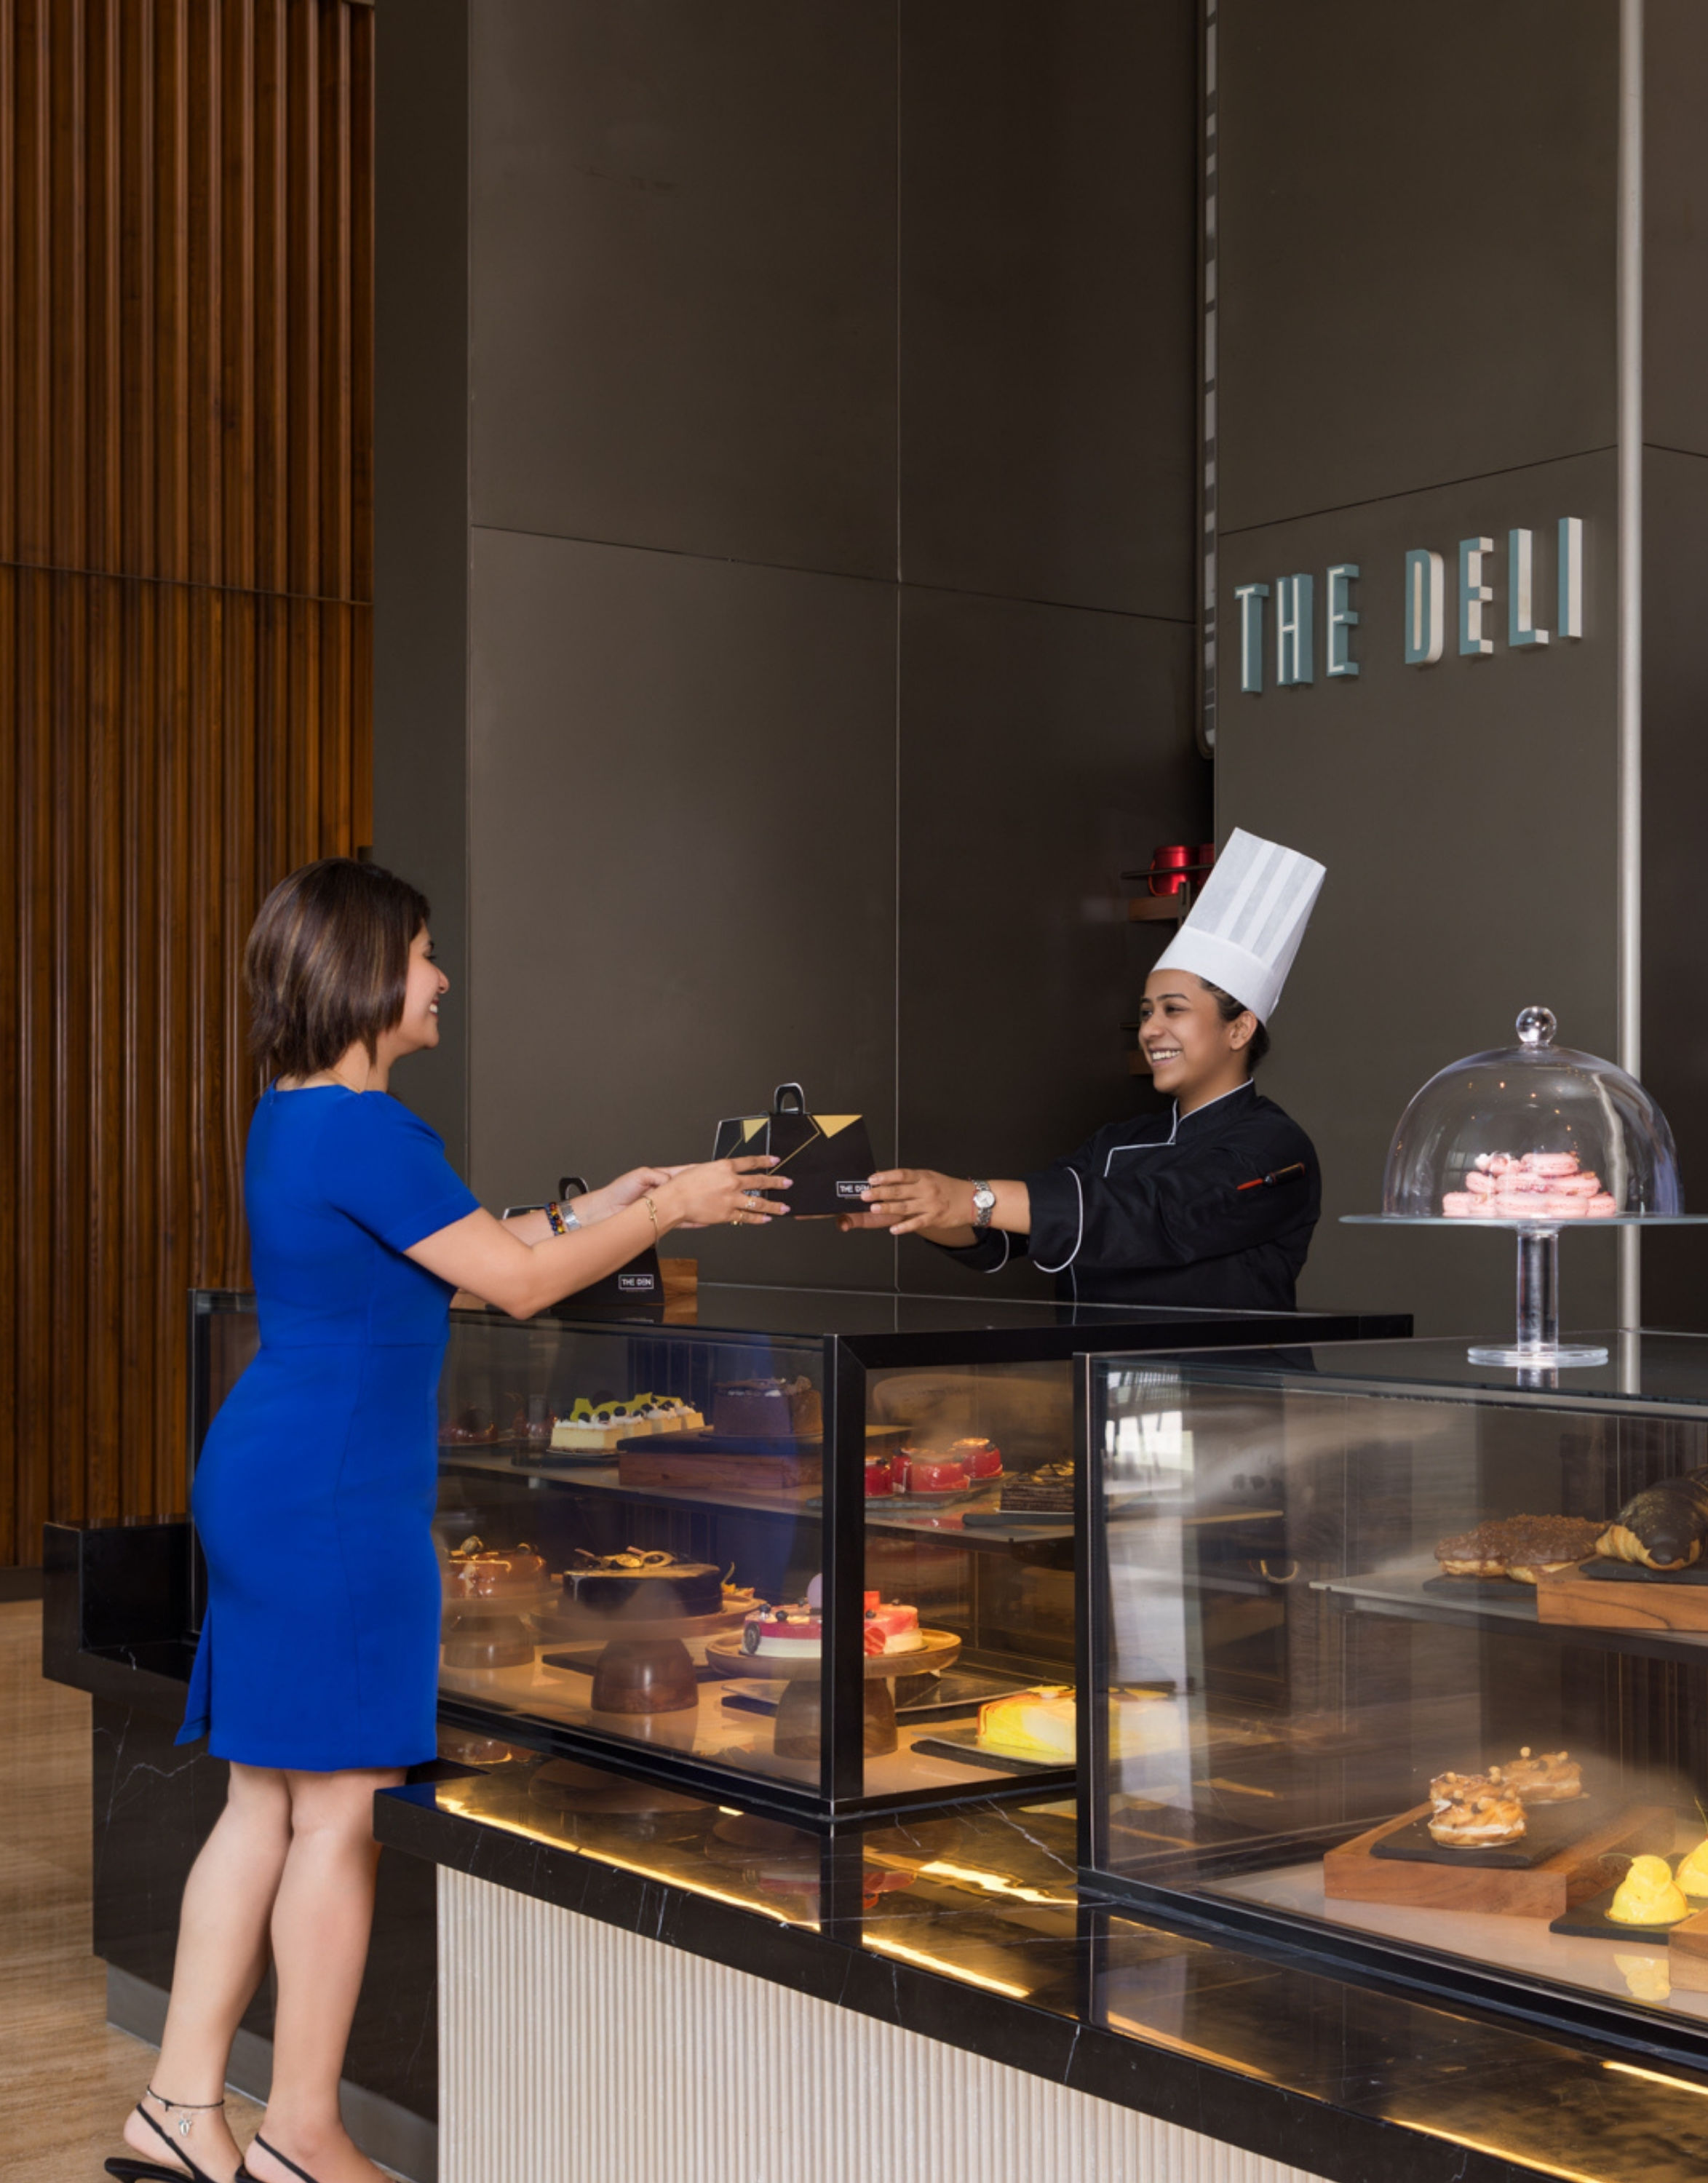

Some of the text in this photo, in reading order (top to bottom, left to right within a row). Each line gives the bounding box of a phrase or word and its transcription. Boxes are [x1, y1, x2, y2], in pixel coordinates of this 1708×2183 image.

[1235, 517, 1583, 693] THE DELI
[839, 1185, 853, 1193] THE
[621, 1278, 651, 1287] THE DEN
